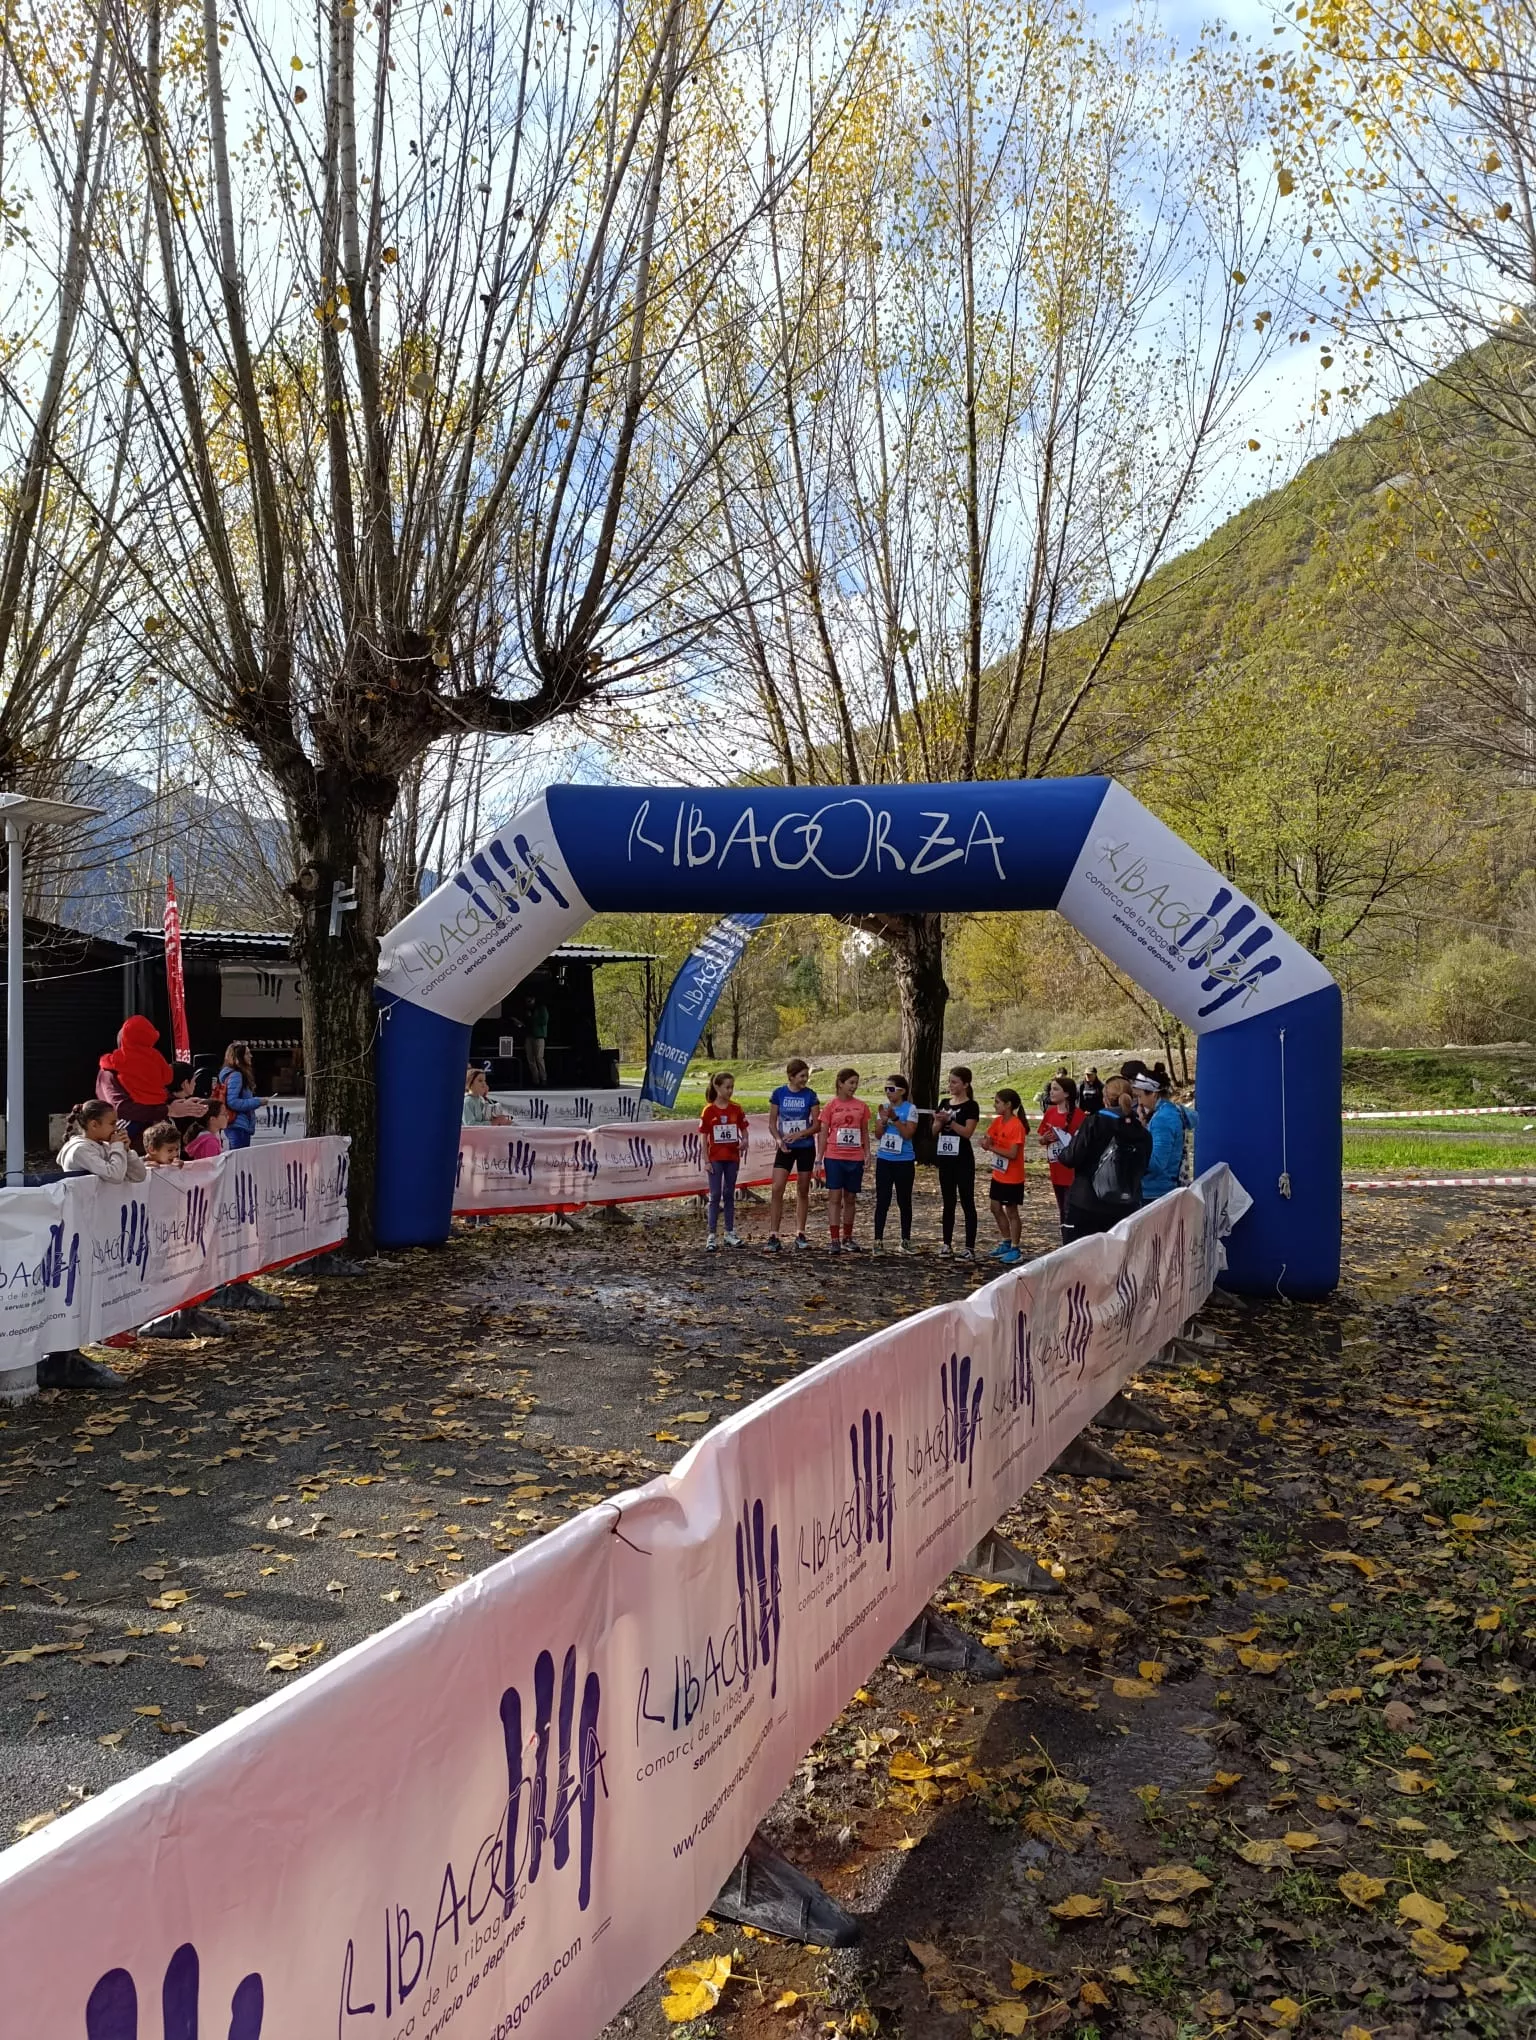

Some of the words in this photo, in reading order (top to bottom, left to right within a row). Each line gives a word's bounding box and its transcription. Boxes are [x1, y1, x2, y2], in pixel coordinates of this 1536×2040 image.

[628, 798, 1006, 880] RIBAGORZA
[398, 839, 558, 984] RIBAGORZA
[1085, 871, 1123, 907] comarca
[1123, 904, 1137, 919] de
[1135, 916, 1146, 929] la
[1145, 925, 1185, 963] ribagza
[1098, 842, 1263, 1009] RIBAGORZA
[421, 962, 458, 996] comarca
[457, 948, 470, 966] de
[468, 942, 478, 956] la
[476, 914, 513, 950] ribagza
[463, 952, 488, 976] servicio
[487, 944, 496, 956] de
[496, 923, 523, 947] deportes
[1112, 913, 1138, 938] servicio
[1137, 935, 1148, 947] de
[1148, 943, 1177, 972] deportes
[483, 1060, 492, 1072] 2
[720, 1131, 732, 1139] 46
[843, 1135, 855, 1144] 42
[885, 1140, 896, 1150] 44
[942, 1142, 953, 1152] 60
[697, 1721, 710, 1741] de
[422, 1979, 440, 2017] de
[446, 1964, 458, 1992] la
[464, 1884, 528, 1967] ribagza
[466, 1973, 480, 1999] de
